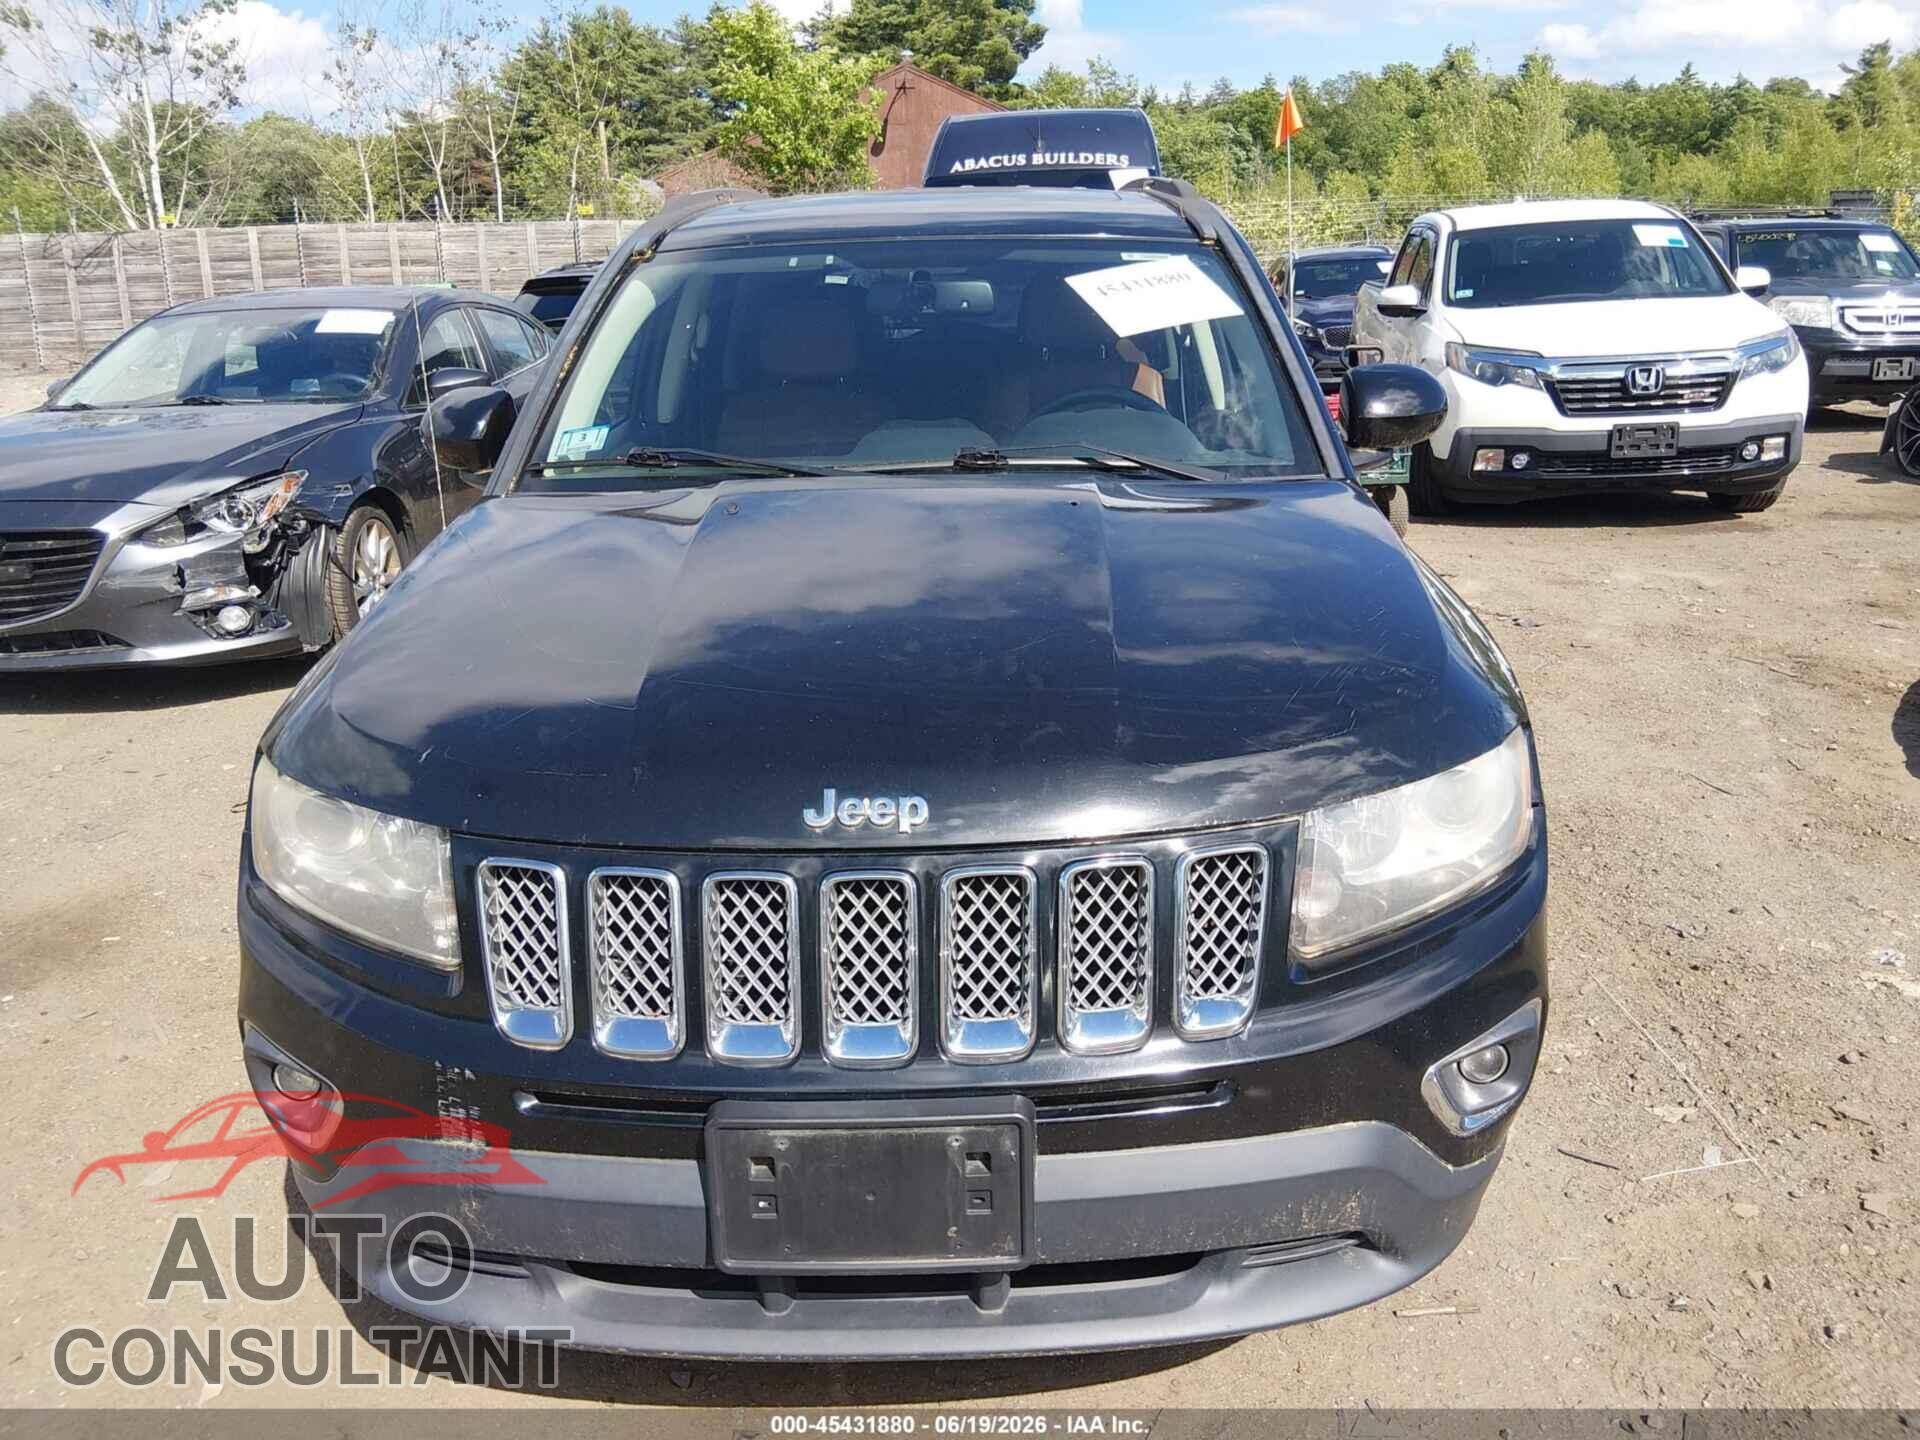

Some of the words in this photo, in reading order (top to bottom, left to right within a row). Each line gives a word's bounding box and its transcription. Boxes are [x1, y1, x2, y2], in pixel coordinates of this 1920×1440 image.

[950, 153, 1027, 174] ABACUS
[1031, 151, 1130, 169] BUILDERS
[803, 788, 929, 834] Jeep
